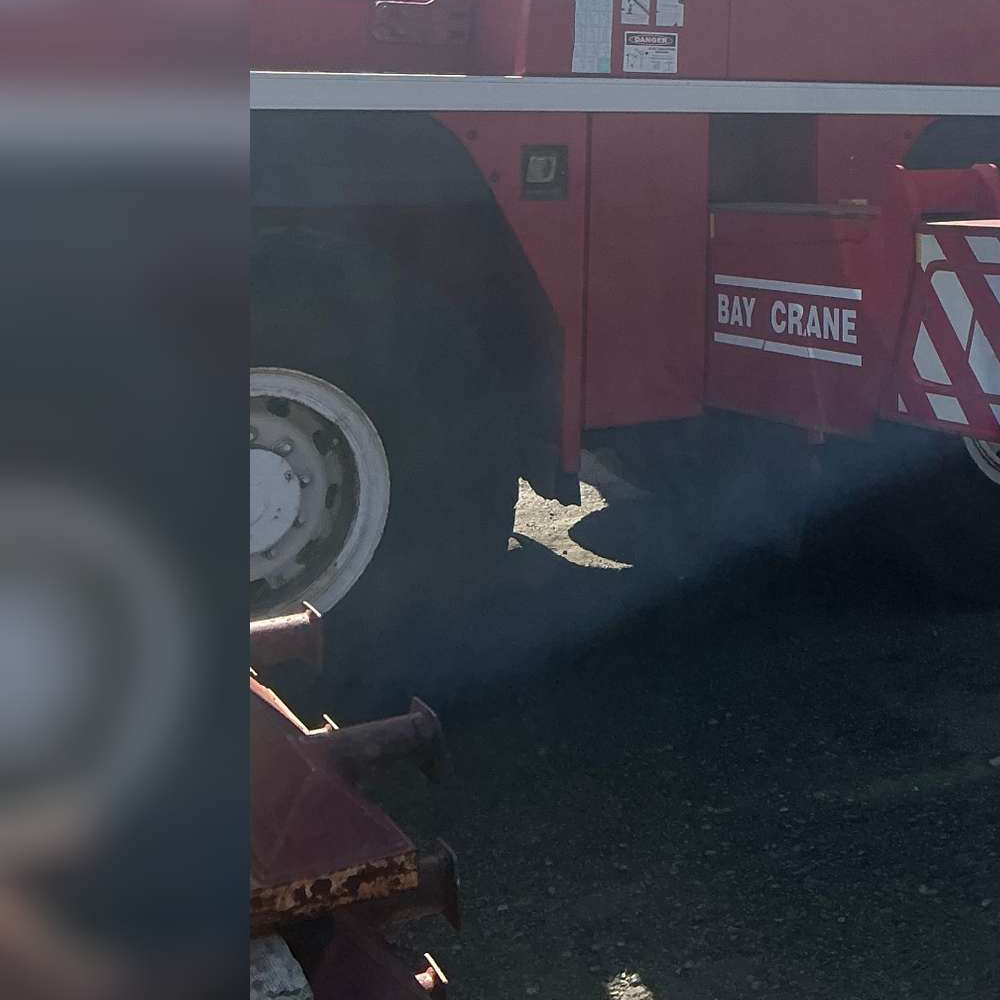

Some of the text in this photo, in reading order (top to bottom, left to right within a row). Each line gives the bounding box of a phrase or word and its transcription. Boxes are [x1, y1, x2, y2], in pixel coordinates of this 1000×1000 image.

[634, 35, 667, 45] DANGER
[717, 293, 857, 344] BAY CRANE
